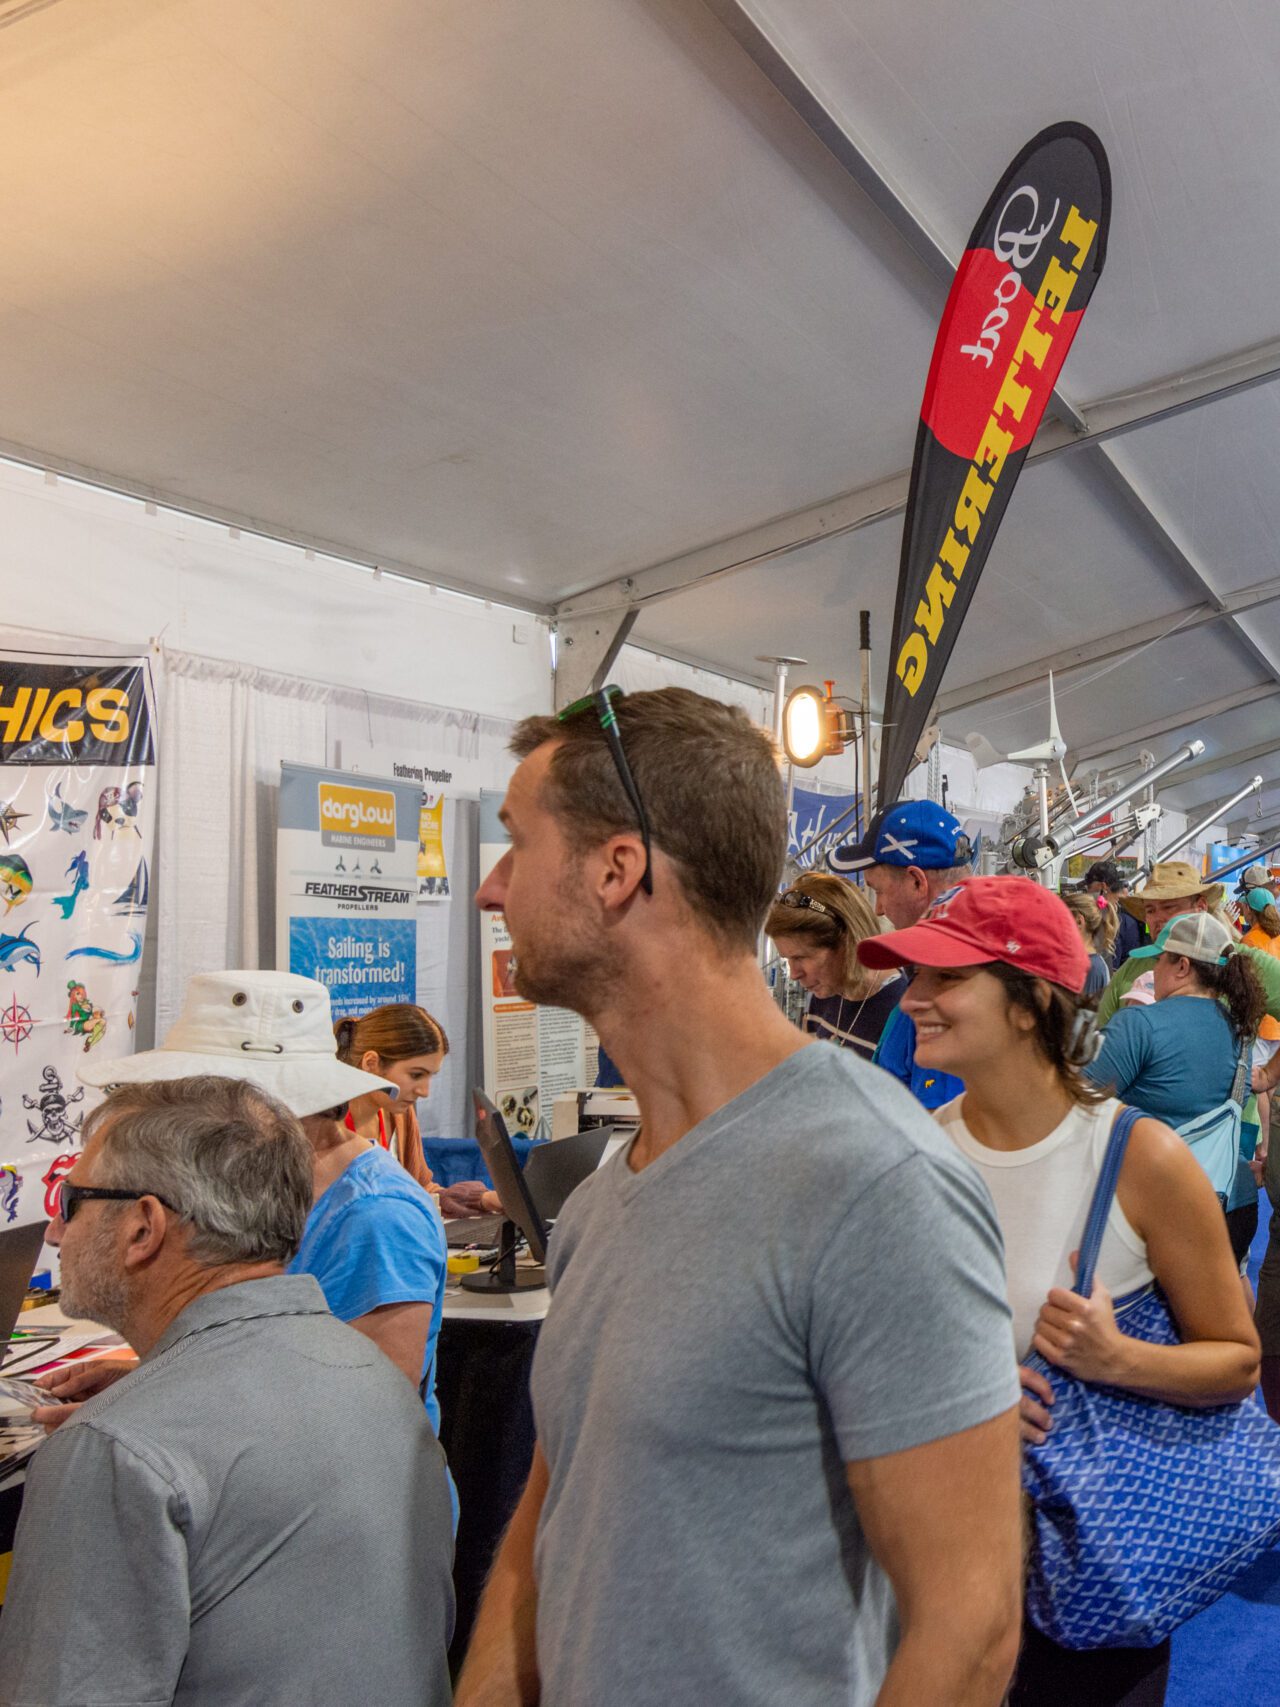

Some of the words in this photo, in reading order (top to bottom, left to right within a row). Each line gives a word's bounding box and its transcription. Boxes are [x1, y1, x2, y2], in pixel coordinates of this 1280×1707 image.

[0, 686, 130, 743] HICS
[393, 762, 423, 782] Feathering
[425, 767, 452, 784] Propeller
[322, 797, 394, 828] darglow
[331, 835, 352, 846] MARINE
[353, 837, 386, 848] ENGINEERS
[337, 903, 379, 911] PROPELLERS
[328, 936, 374, 964] Sailing
[378, 937, 391, 959] is
[315, 960, 405, 985] transformed!
